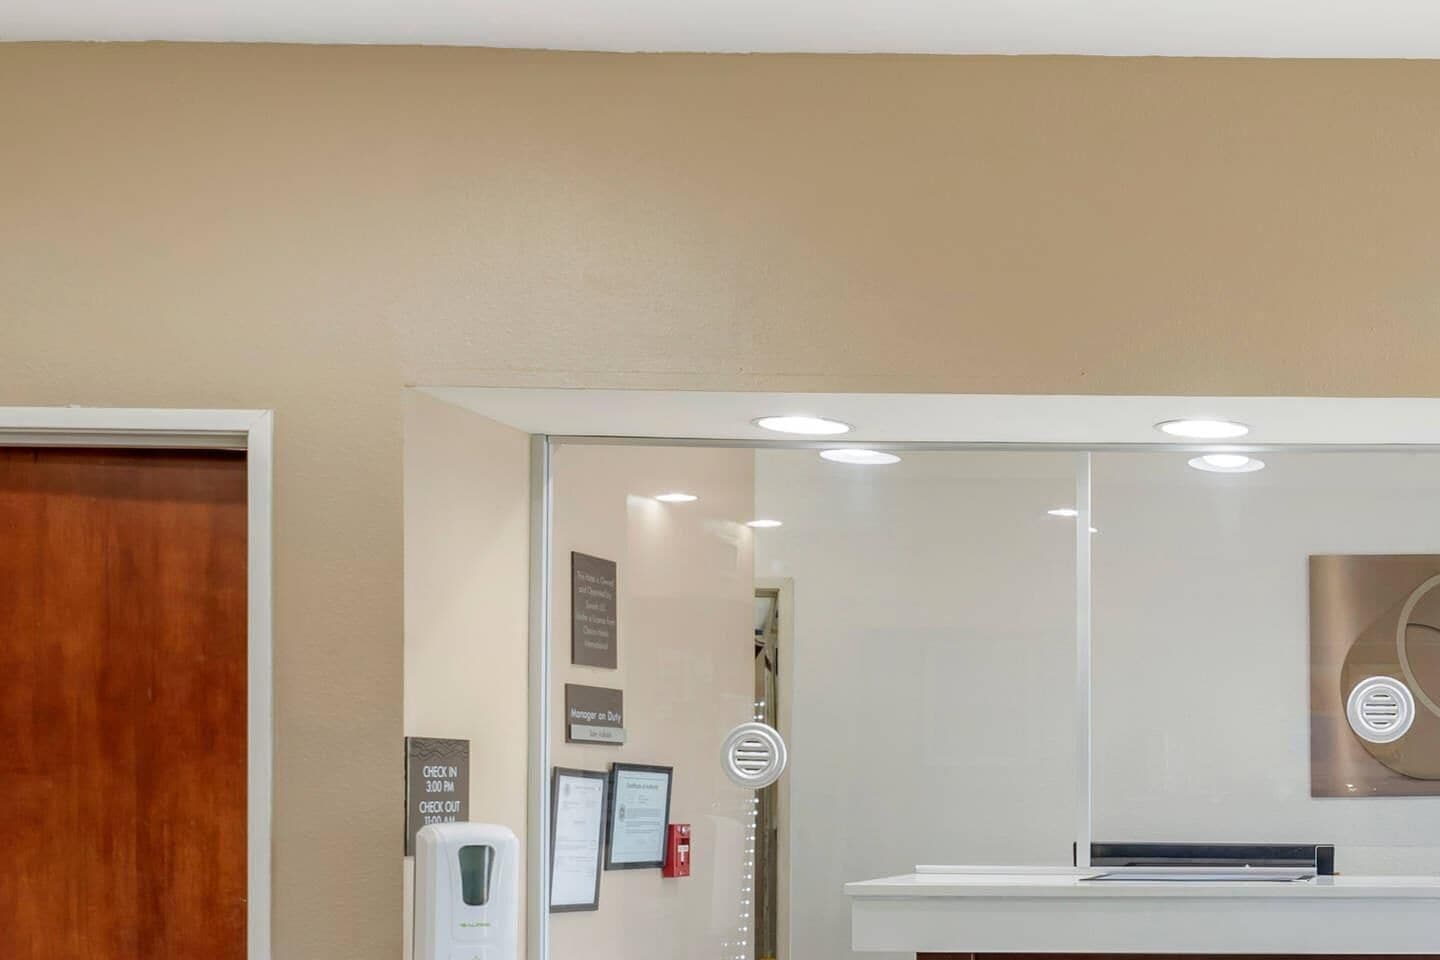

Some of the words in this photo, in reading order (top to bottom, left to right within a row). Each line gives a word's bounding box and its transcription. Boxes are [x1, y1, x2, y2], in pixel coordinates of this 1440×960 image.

[571, 706, 597, 722] Manager
[598, 712, 607, 721] on
[607, 710, 621, 725] Duty
[422, 766, 448, 778] CHECK
[448, 766, 458, 778] IN
[425, 780, 443, 793] 3:00
[443, 780, 455, 793] PM
[418, 800, 444, 814] CHECK
[444, 800, 461, 813] OUT
